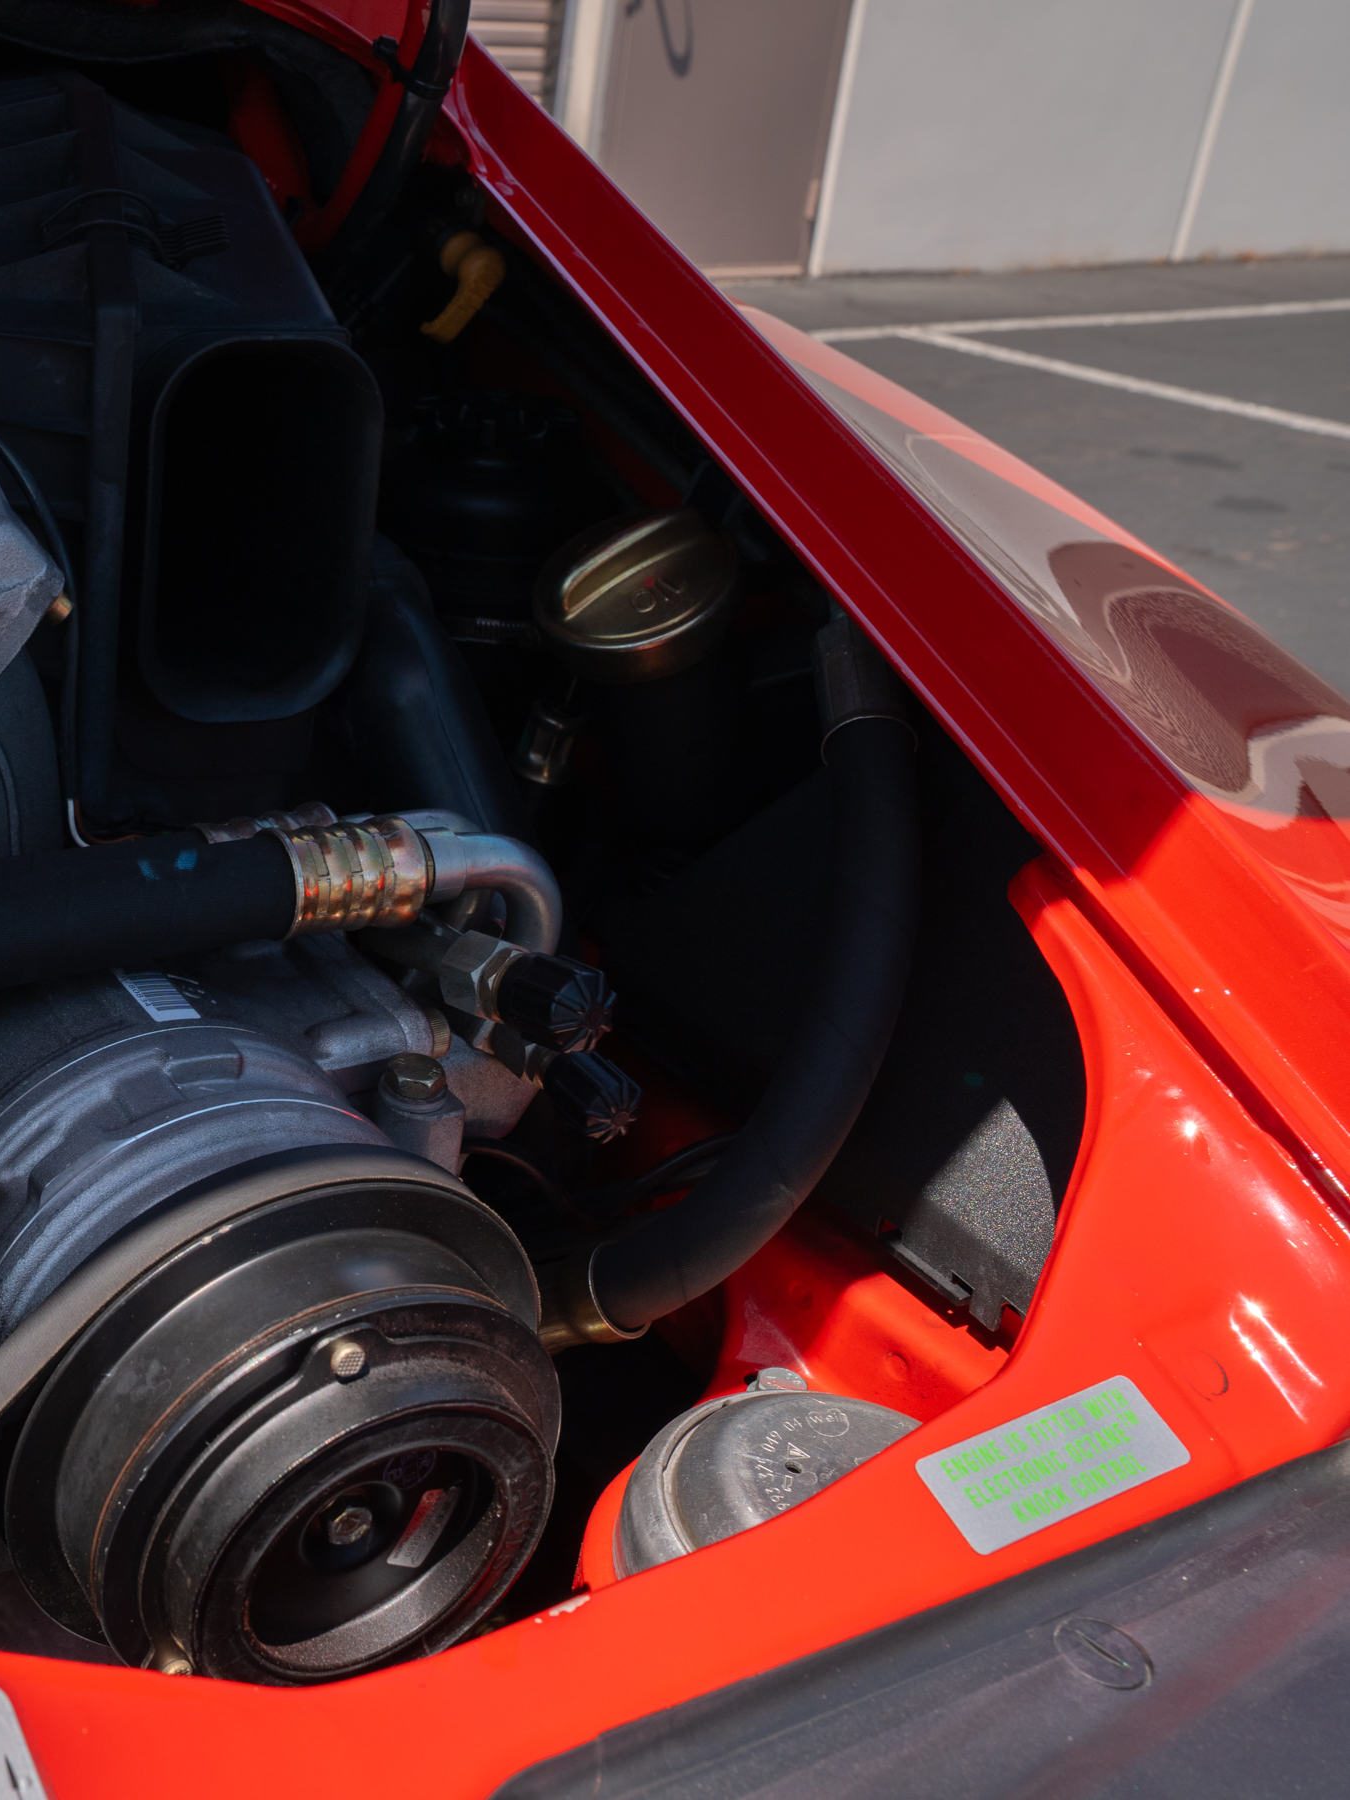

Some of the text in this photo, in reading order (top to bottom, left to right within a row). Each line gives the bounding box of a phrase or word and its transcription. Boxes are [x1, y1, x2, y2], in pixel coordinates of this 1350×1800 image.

[939, 1387, 1131, 1482] ENGINE IS FITTED WITH
[963, 1449, 1068, 1509] ELECTRONIC
[1009, 1452, 1148, 1525] KNOCK CONTROL
